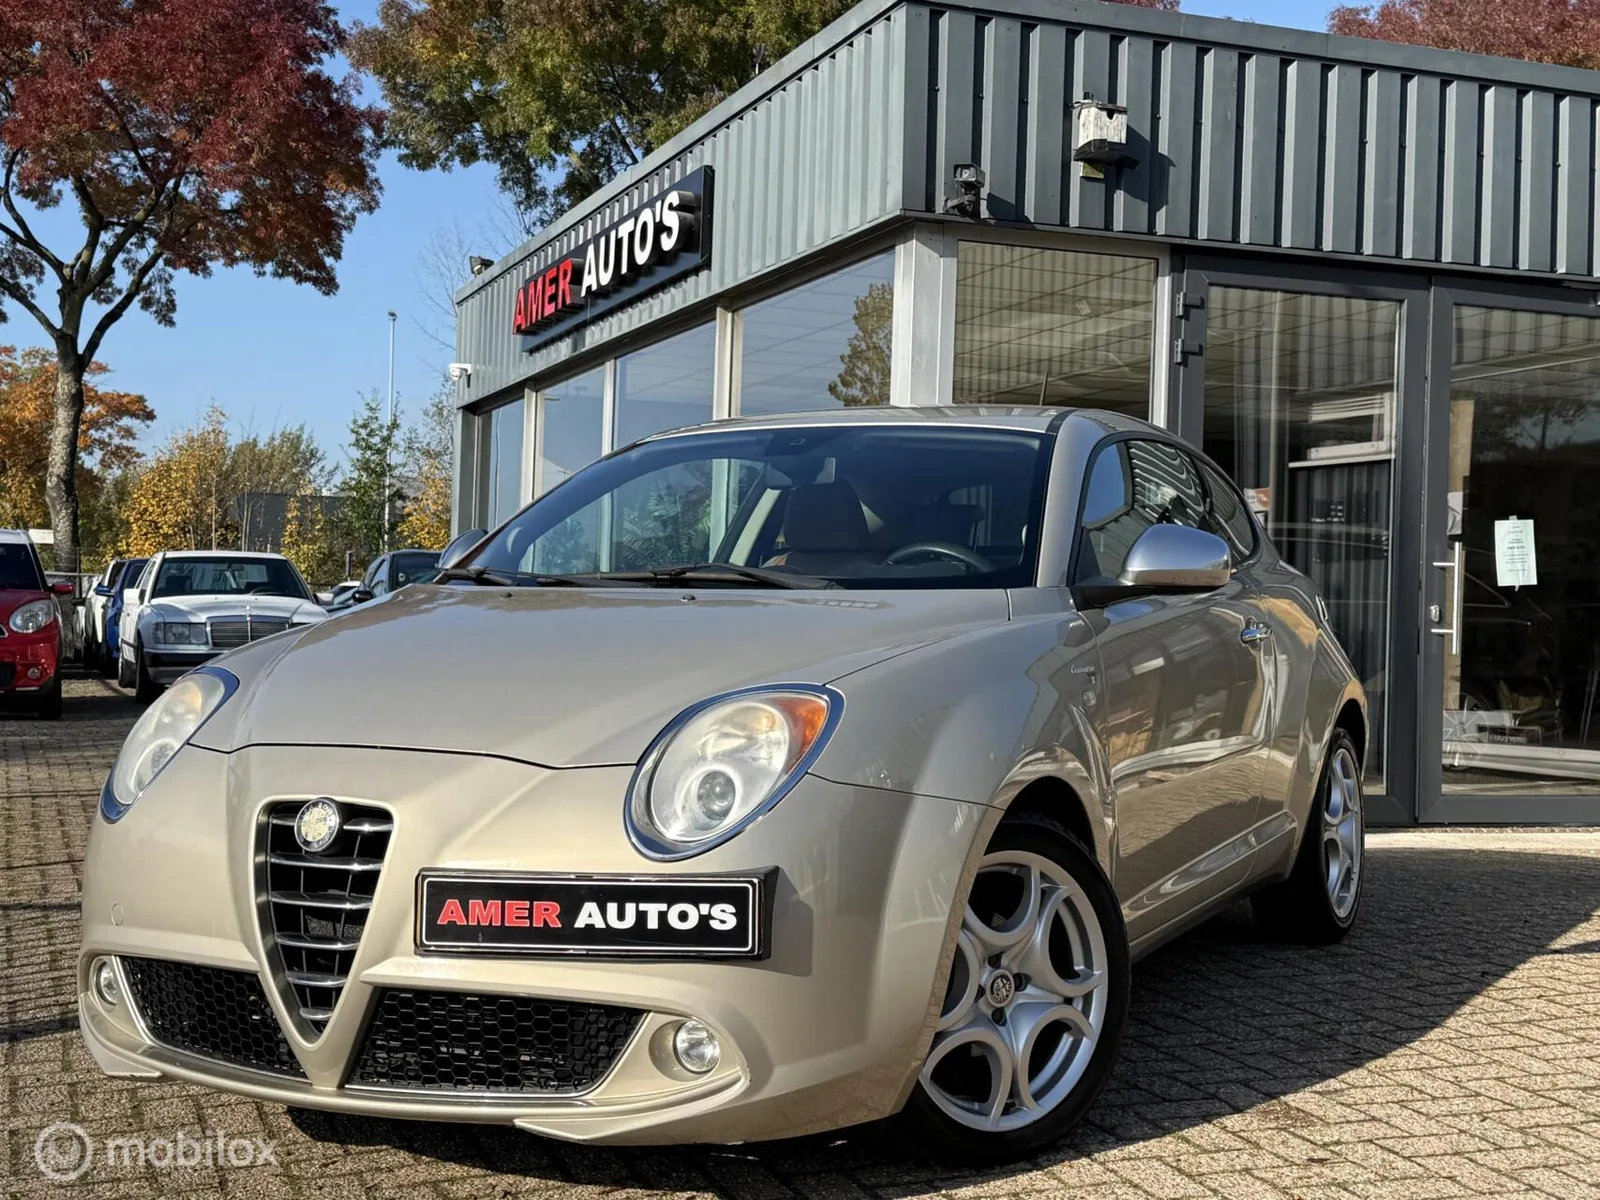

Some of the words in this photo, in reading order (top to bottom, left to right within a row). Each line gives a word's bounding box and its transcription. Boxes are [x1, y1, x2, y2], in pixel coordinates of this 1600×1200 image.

[513, 259, 573, 335] AMER
[581, 190, 681, 298] AUTO'S
[436, 898, 562, 928] AMER
[573, 901, 738, 931] AUTO'S
